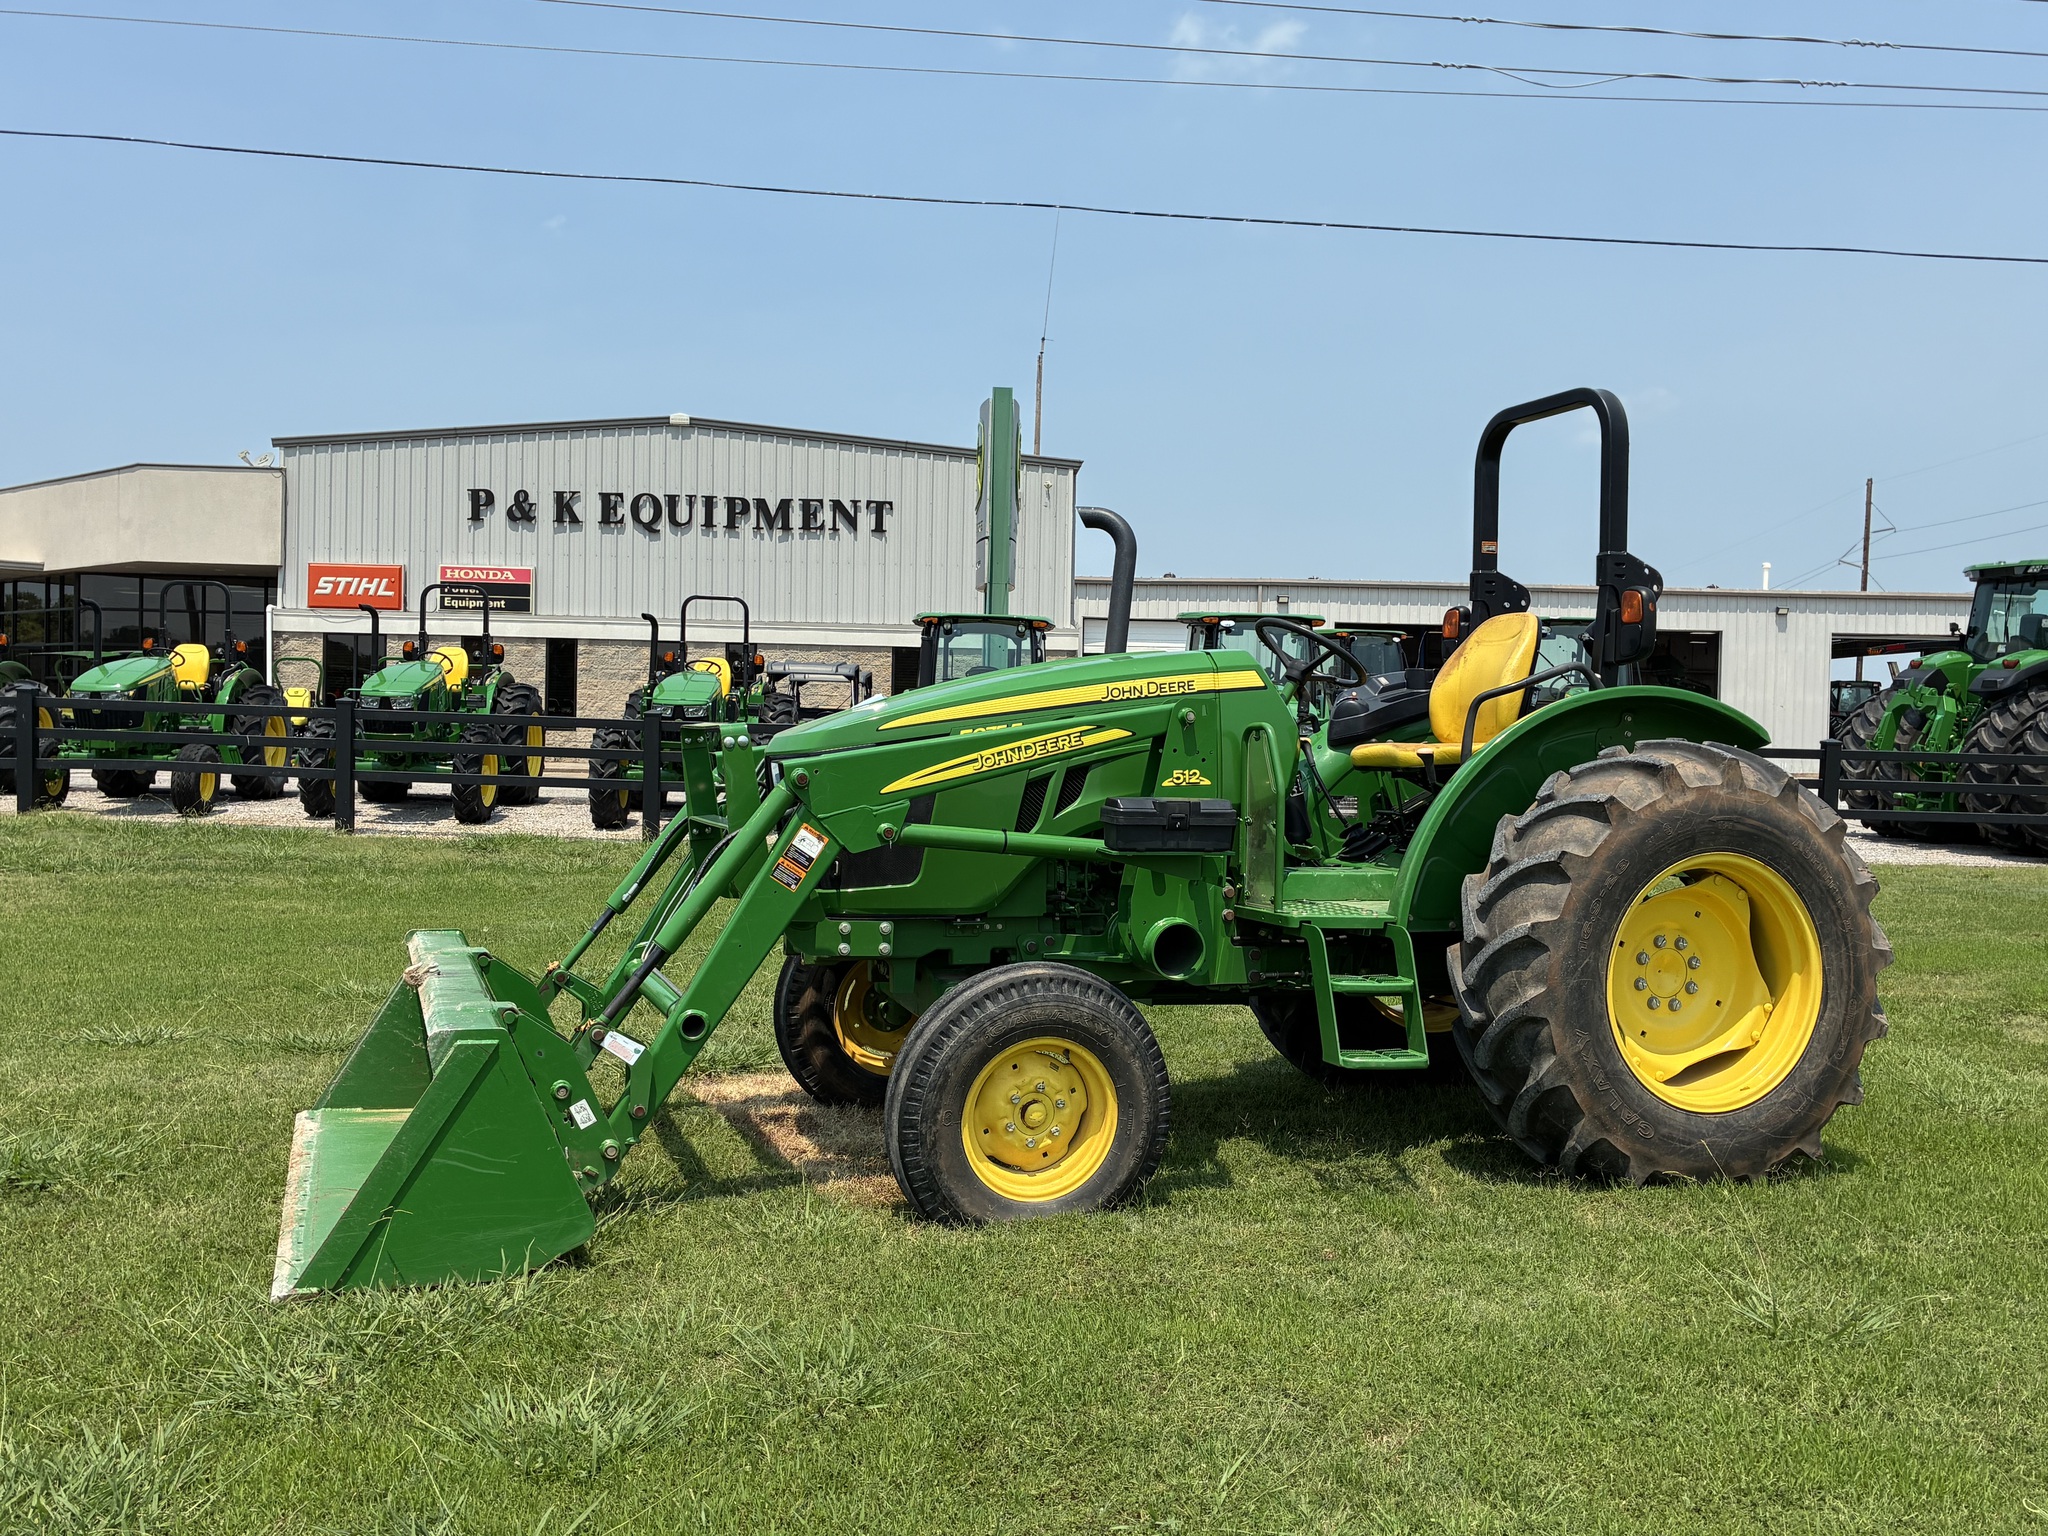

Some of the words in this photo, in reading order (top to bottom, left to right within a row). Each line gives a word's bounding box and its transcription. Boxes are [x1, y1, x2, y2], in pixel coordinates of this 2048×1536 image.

[467, 488, 495, 521] P
[506, 489, 537, 523] &
[552, 490, 582, 524] K
[598, 491, 894, 533] EQUIPMENT
[445, 568, 516, 580] HONDA
[314, 576, 395, 596] STIHL
[444, 597, 506, 609] Equipment
[1101, 684, 1143, 700] JOHN
[1147, 680, 1196, 695] DEERE
[973, 747, 1021, 771] JOHN
[1021, 732, 1084, 760] DEERE
[1172, 769, 1201, 785] 512
[1575, 1028, 1655, 1139] GALAXY
